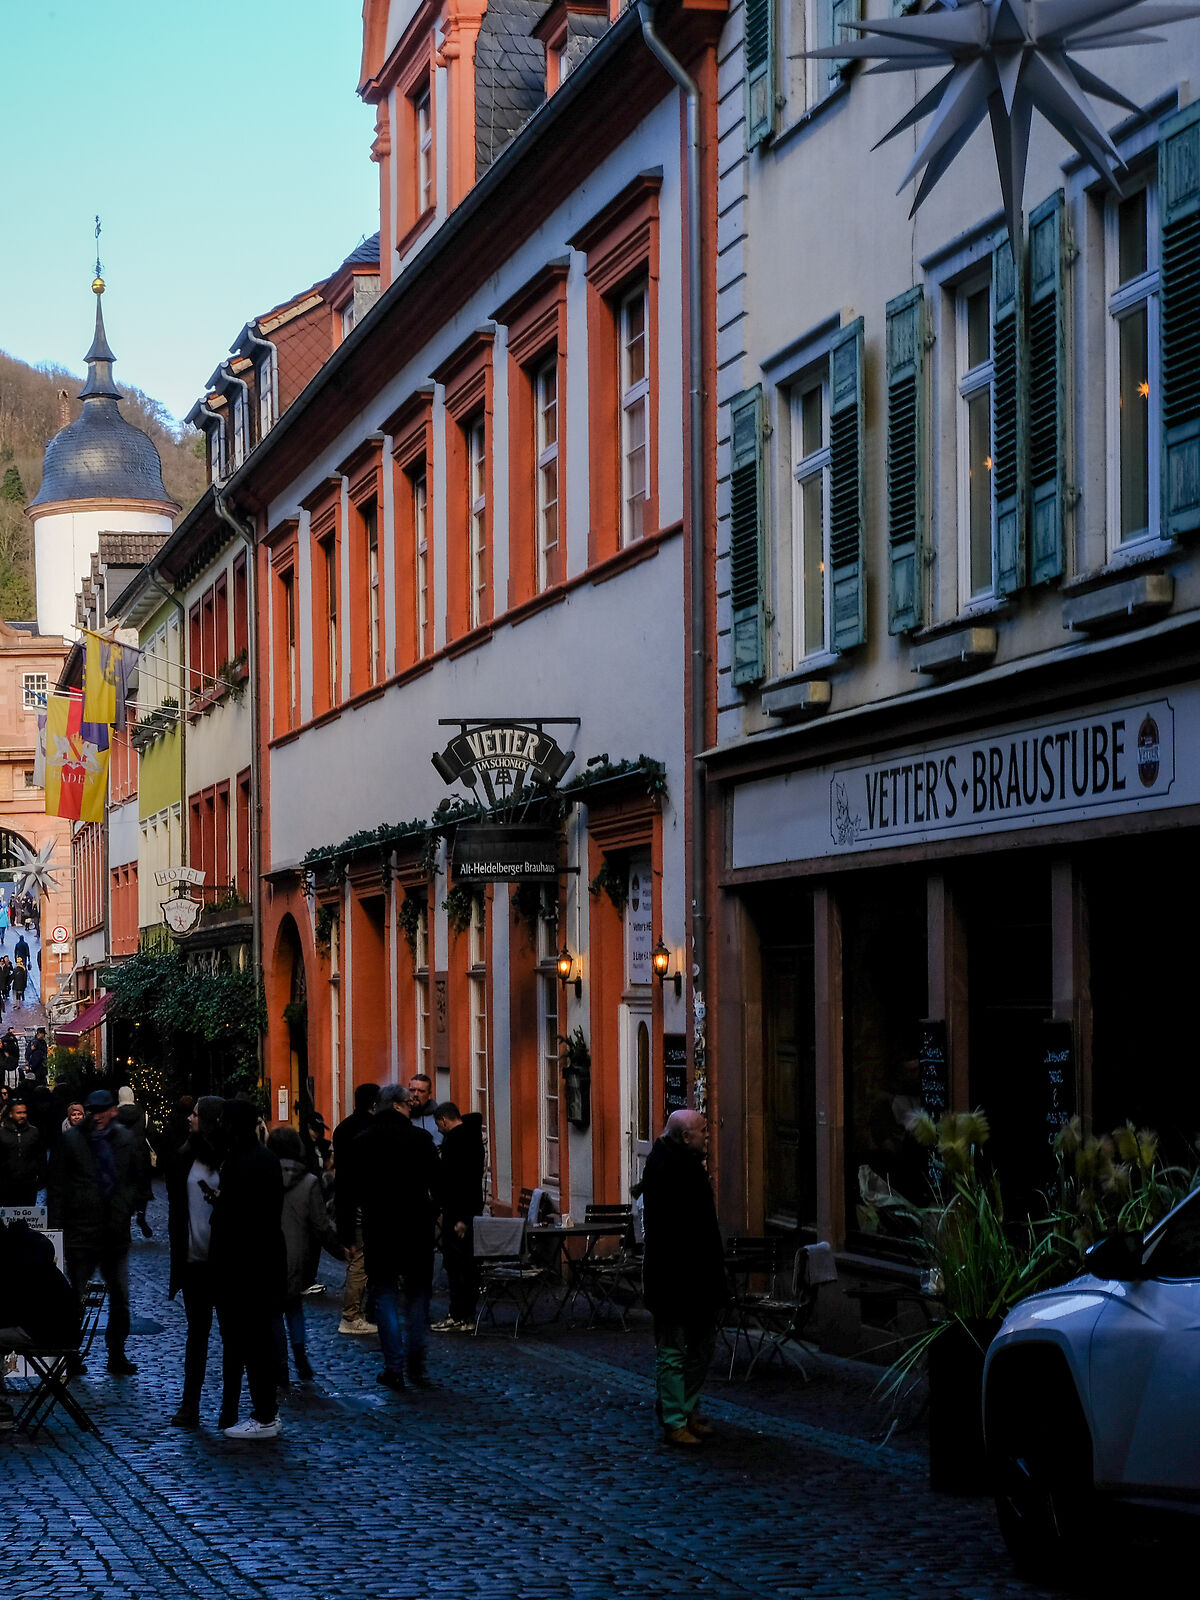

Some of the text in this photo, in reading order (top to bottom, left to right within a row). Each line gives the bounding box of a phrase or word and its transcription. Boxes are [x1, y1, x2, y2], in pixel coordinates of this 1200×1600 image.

[465, 728, 540, 763] VETTER
[477, 760, 491, 772] IM
[865, 720, 1126, 830] VETTER'S BRAUSTUBE
[158, 868, 201, 884] HOTEL
[460, 861, 555, 876] Alt-Heidelberger Brauhaus
